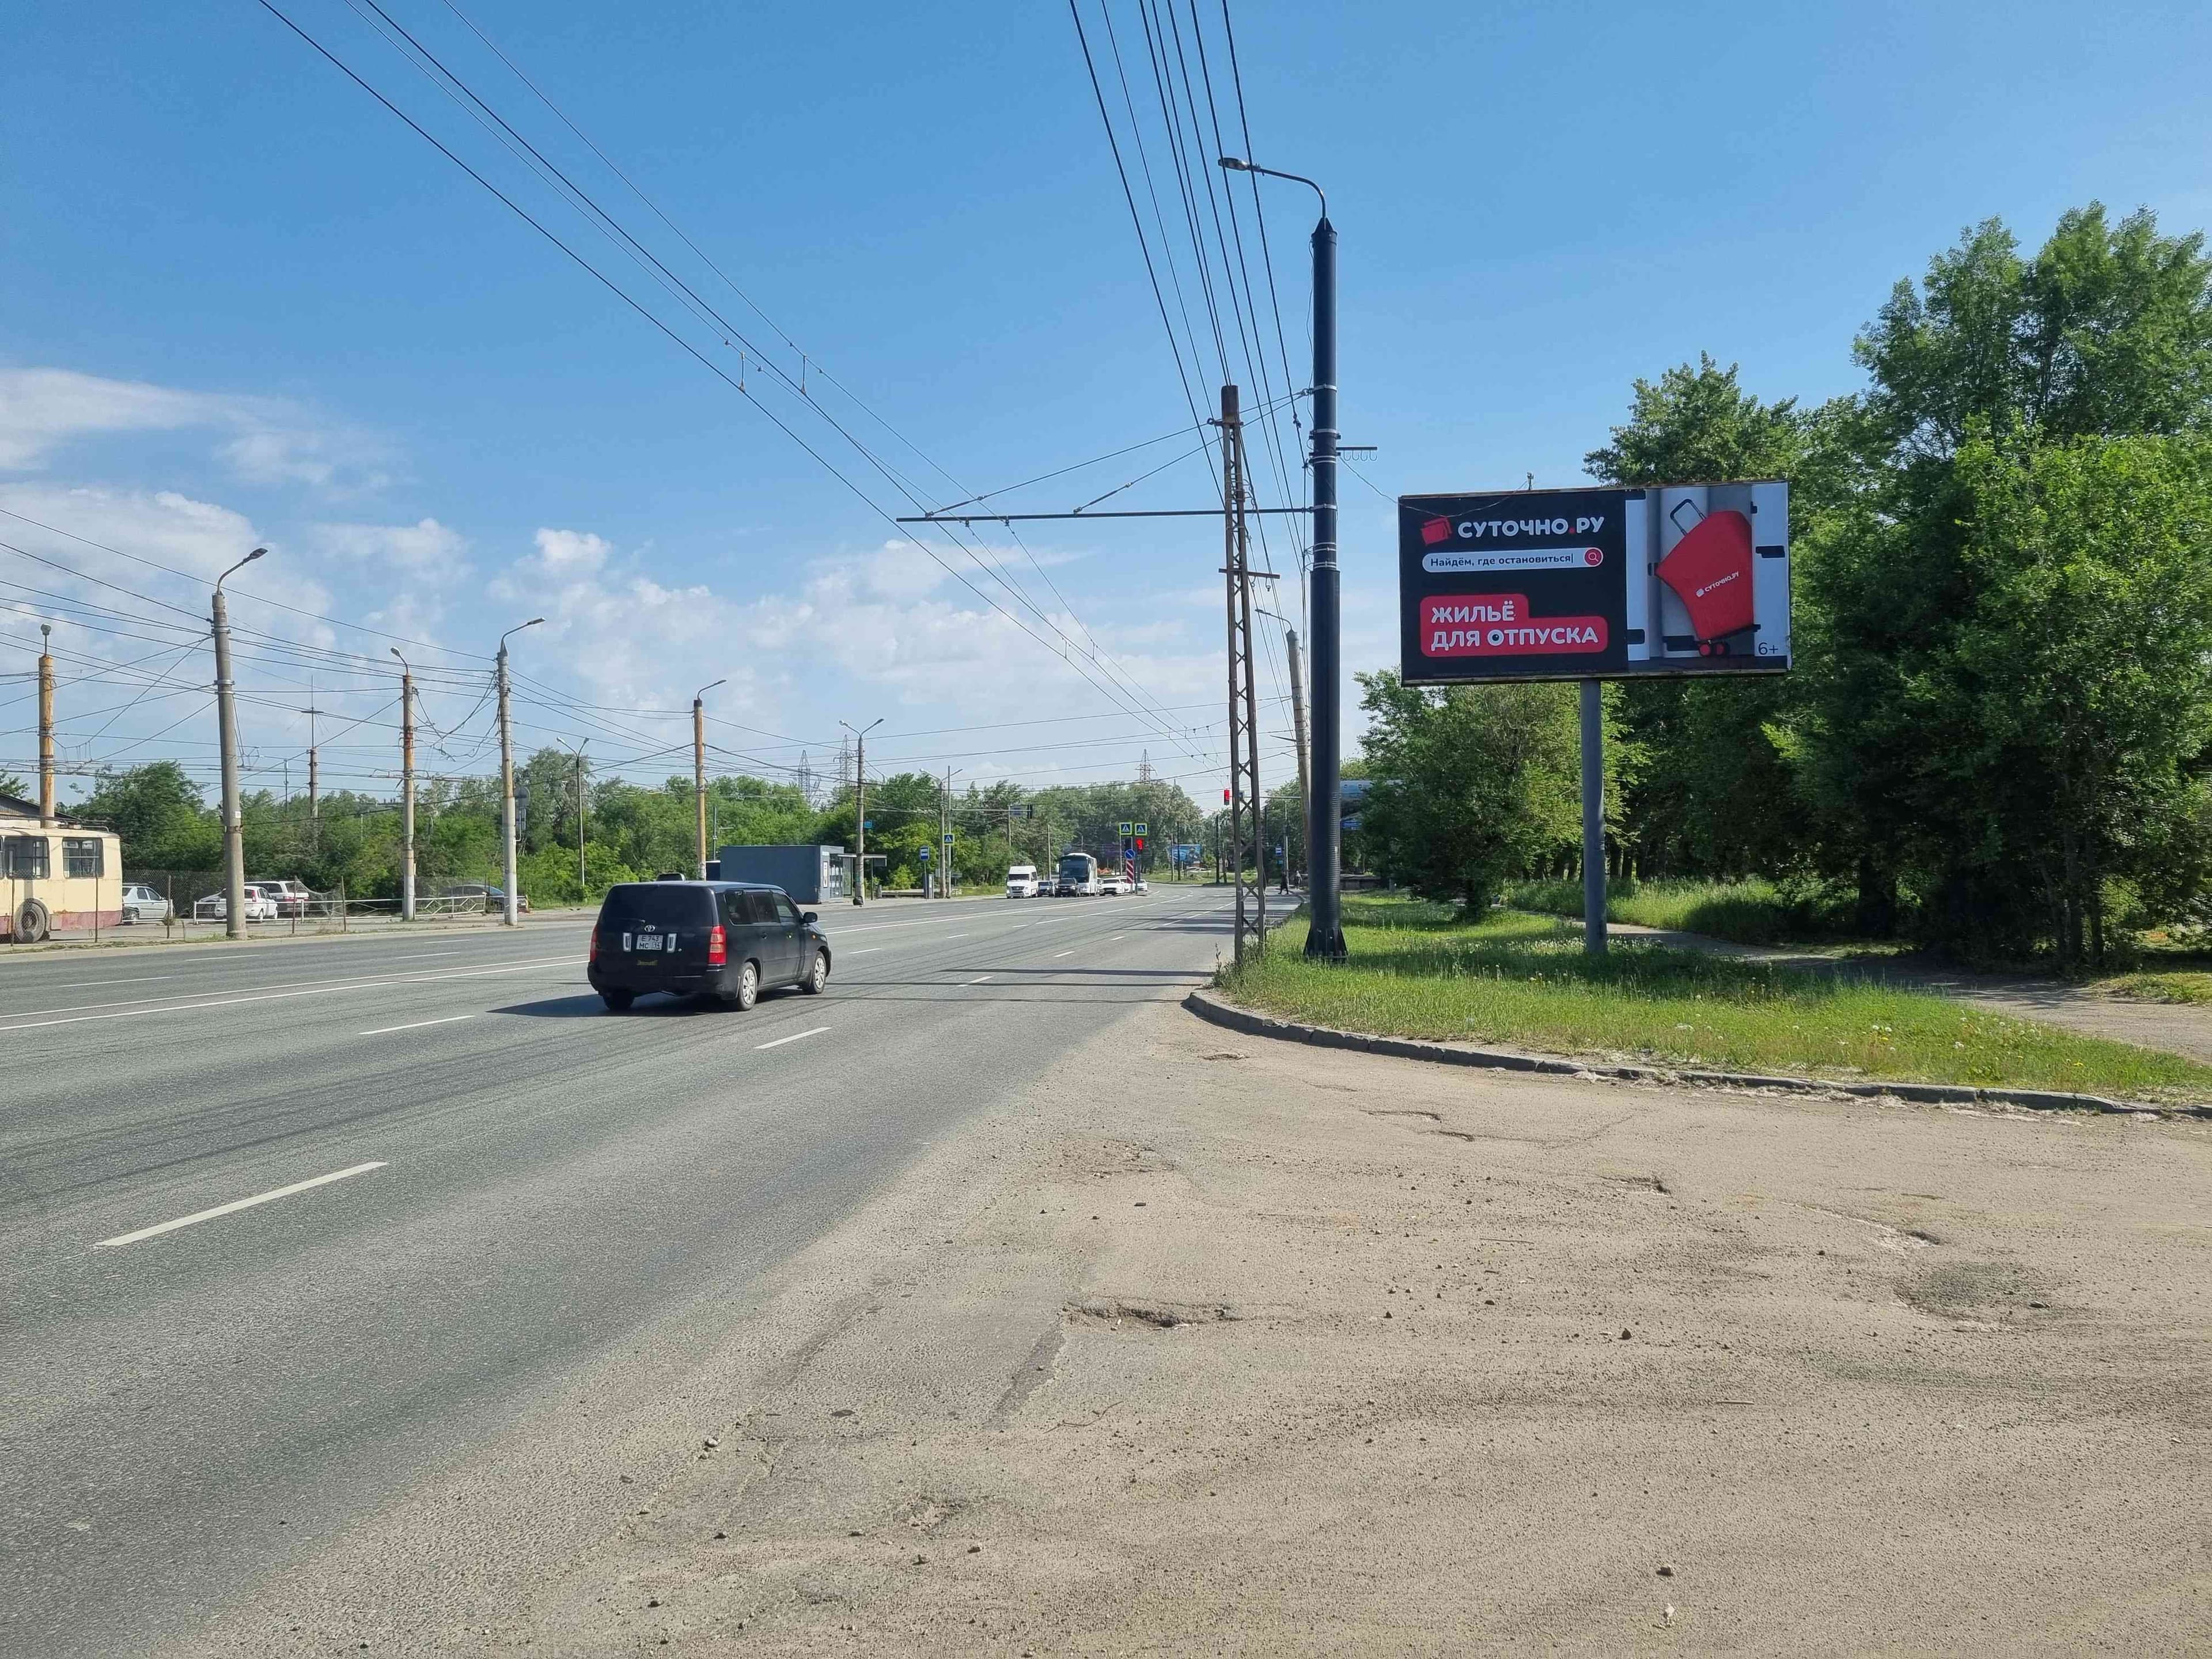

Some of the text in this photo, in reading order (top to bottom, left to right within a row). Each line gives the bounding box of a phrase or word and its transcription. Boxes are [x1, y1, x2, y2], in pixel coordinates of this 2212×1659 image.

[1457, 517, 1604, 538] СУТОЧНО.РУ
[1430, 556, 1475, 567] Найдём,
[1478, 558, 1496, 567] где
[1705, 571, 1739, 592] СУТОЧНО.РУ
[1431, 600, 1515, 623] ЖИЛЬЁ
[1431, 627, 1599, 652] ДЛЯ ОТПУСКА
[1758, 642, 1779, 655] 6+
